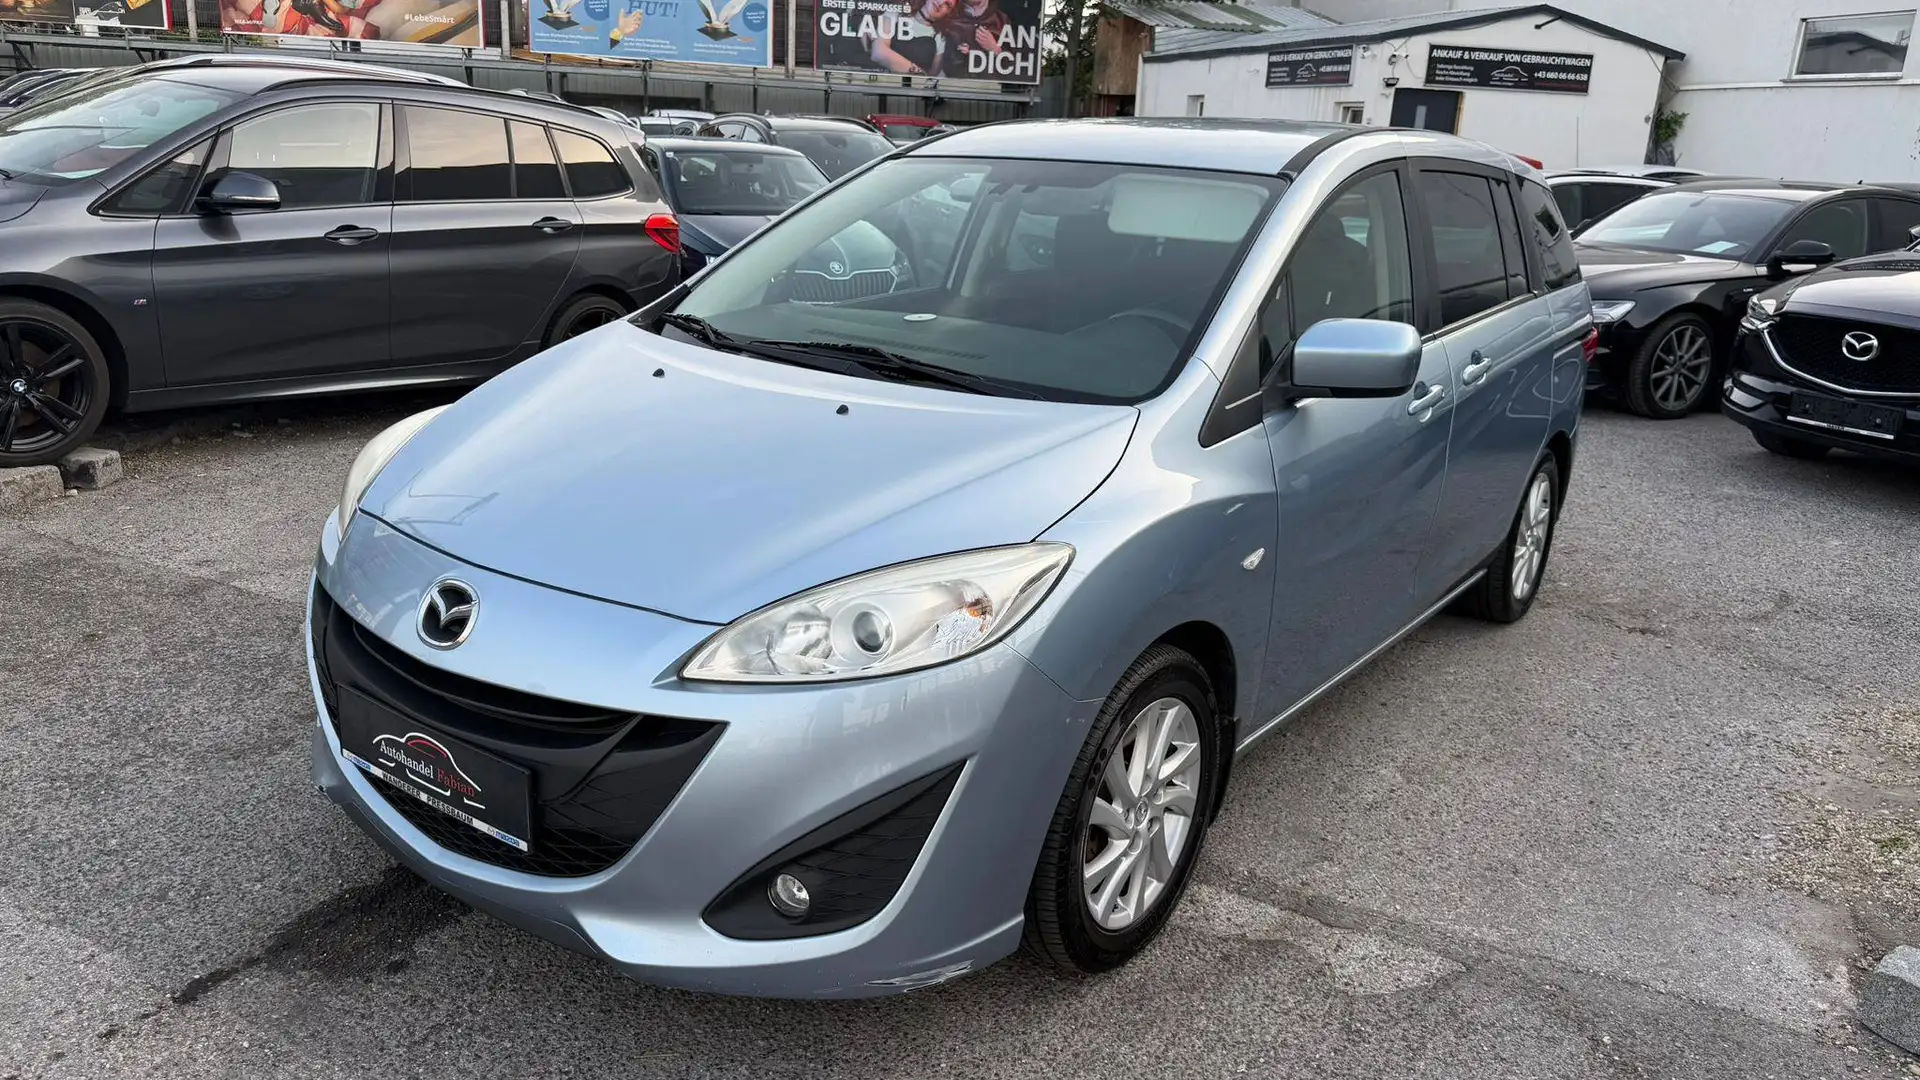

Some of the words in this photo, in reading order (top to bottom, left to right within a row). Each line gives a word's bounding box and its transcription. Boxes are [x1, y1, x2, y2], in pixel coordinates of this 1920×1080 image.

[822, 0, 846, 9] ERSTE
[857, 2, 902, 13] SPARKASSE
[820, 12, 914, 40] GLAUB
[997, 24, 1036, 49] AN
[968, 50, 1034, 76] DICH
[1431, 48, 1464, 59] ANKAUF
[1463, 51, 1470, 60] &
[1470, 51, 1504, 61] VERKAUF
[1504, 53, 1521, 63] VON
[1521, 54, 1591, 67] GEBRAUCHTWAGEN
[379, 740, 434, 779] Autohandel
[437, 768, 476, 797] Fabian
[382, 772, 422, 800] WANDERER
[426, 795, 474, 826] PRESSBAUM
